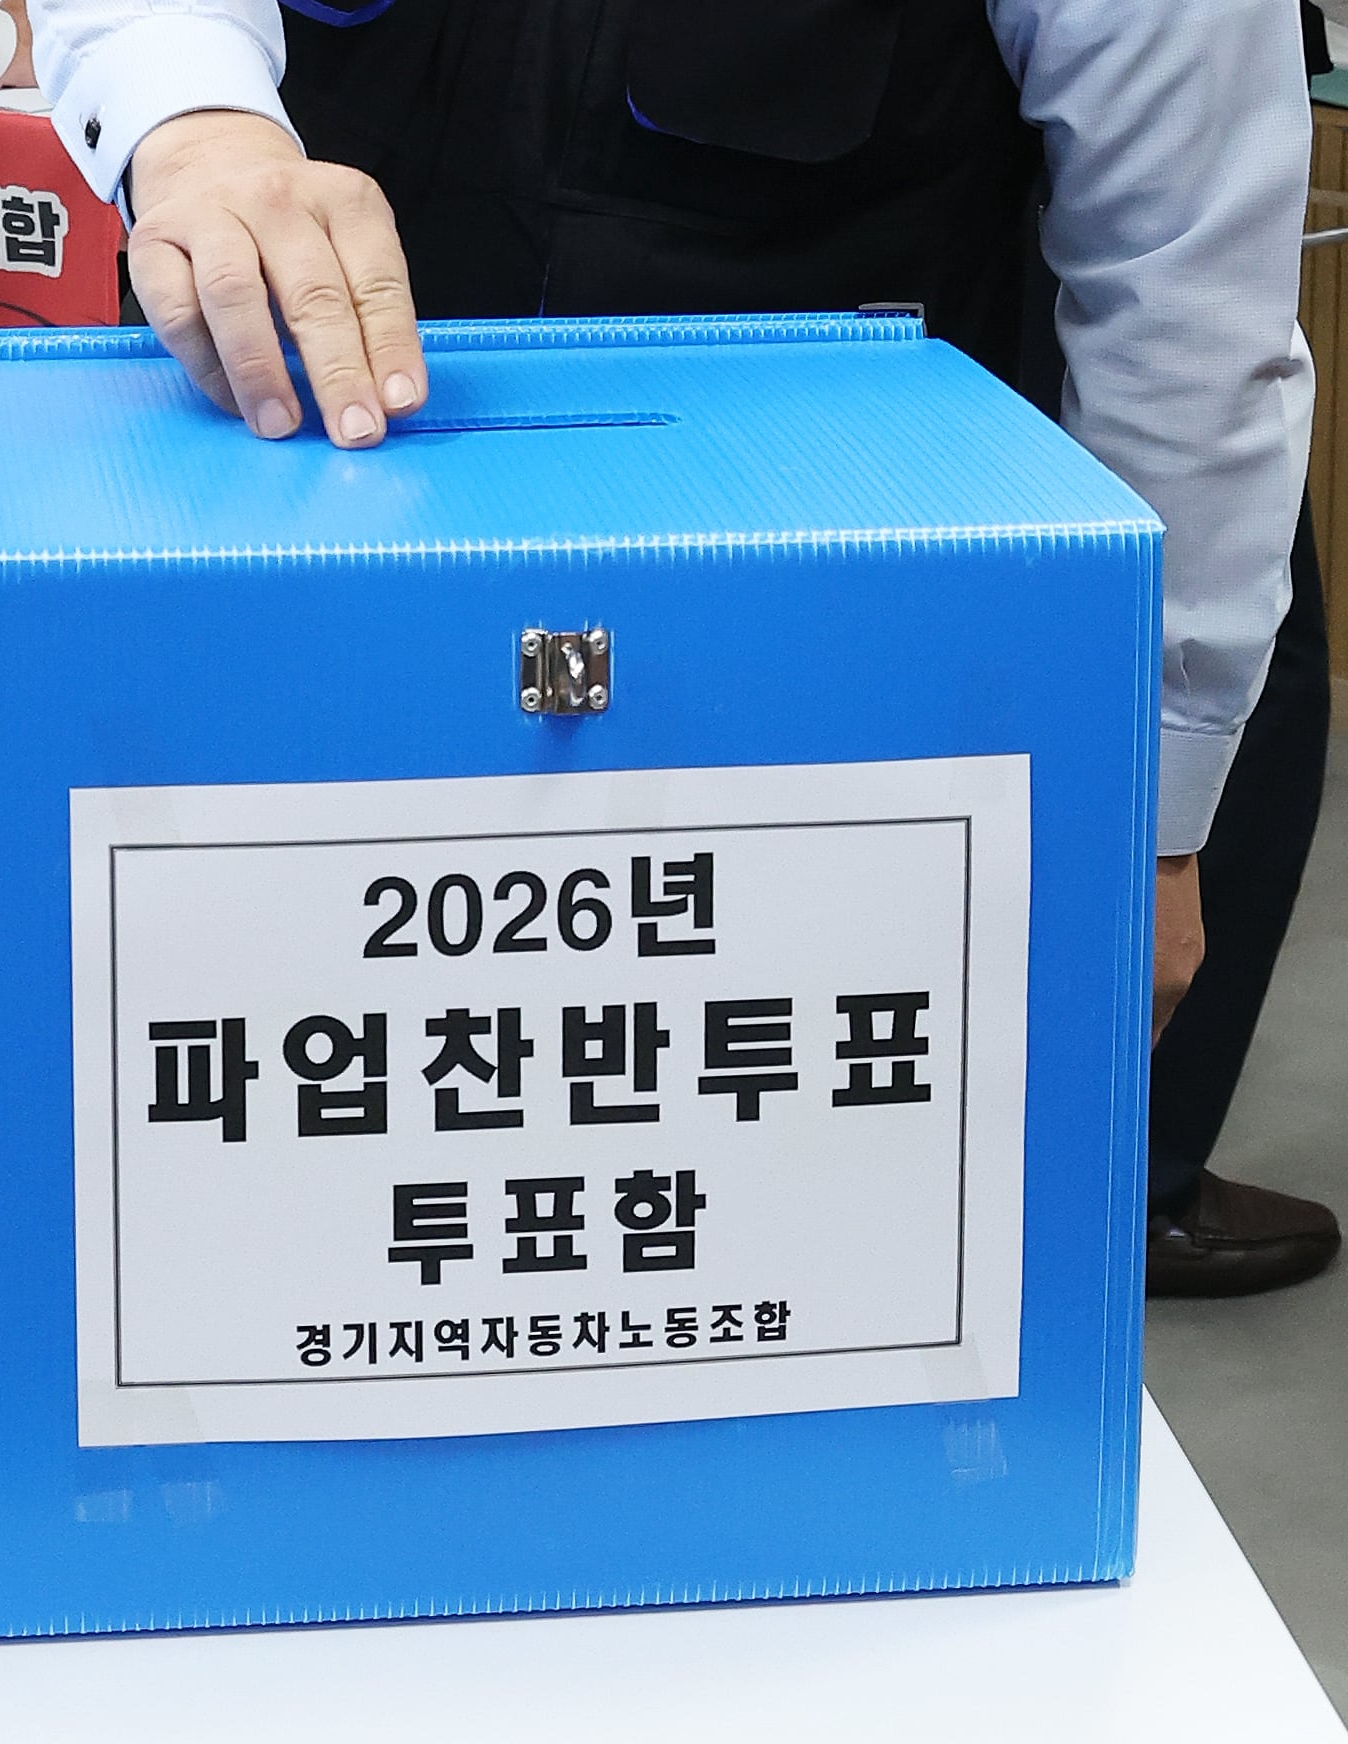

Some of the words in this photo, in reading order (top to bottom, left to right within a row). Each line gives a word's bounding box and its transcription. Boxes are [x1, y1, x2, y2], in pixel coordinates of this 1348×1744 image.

[362, 853, 716, 959] 2026년
[387, 1169, 707, 1287] 투표함
[295, 1300, 791, 1368] 경기지역자동차노동조합
